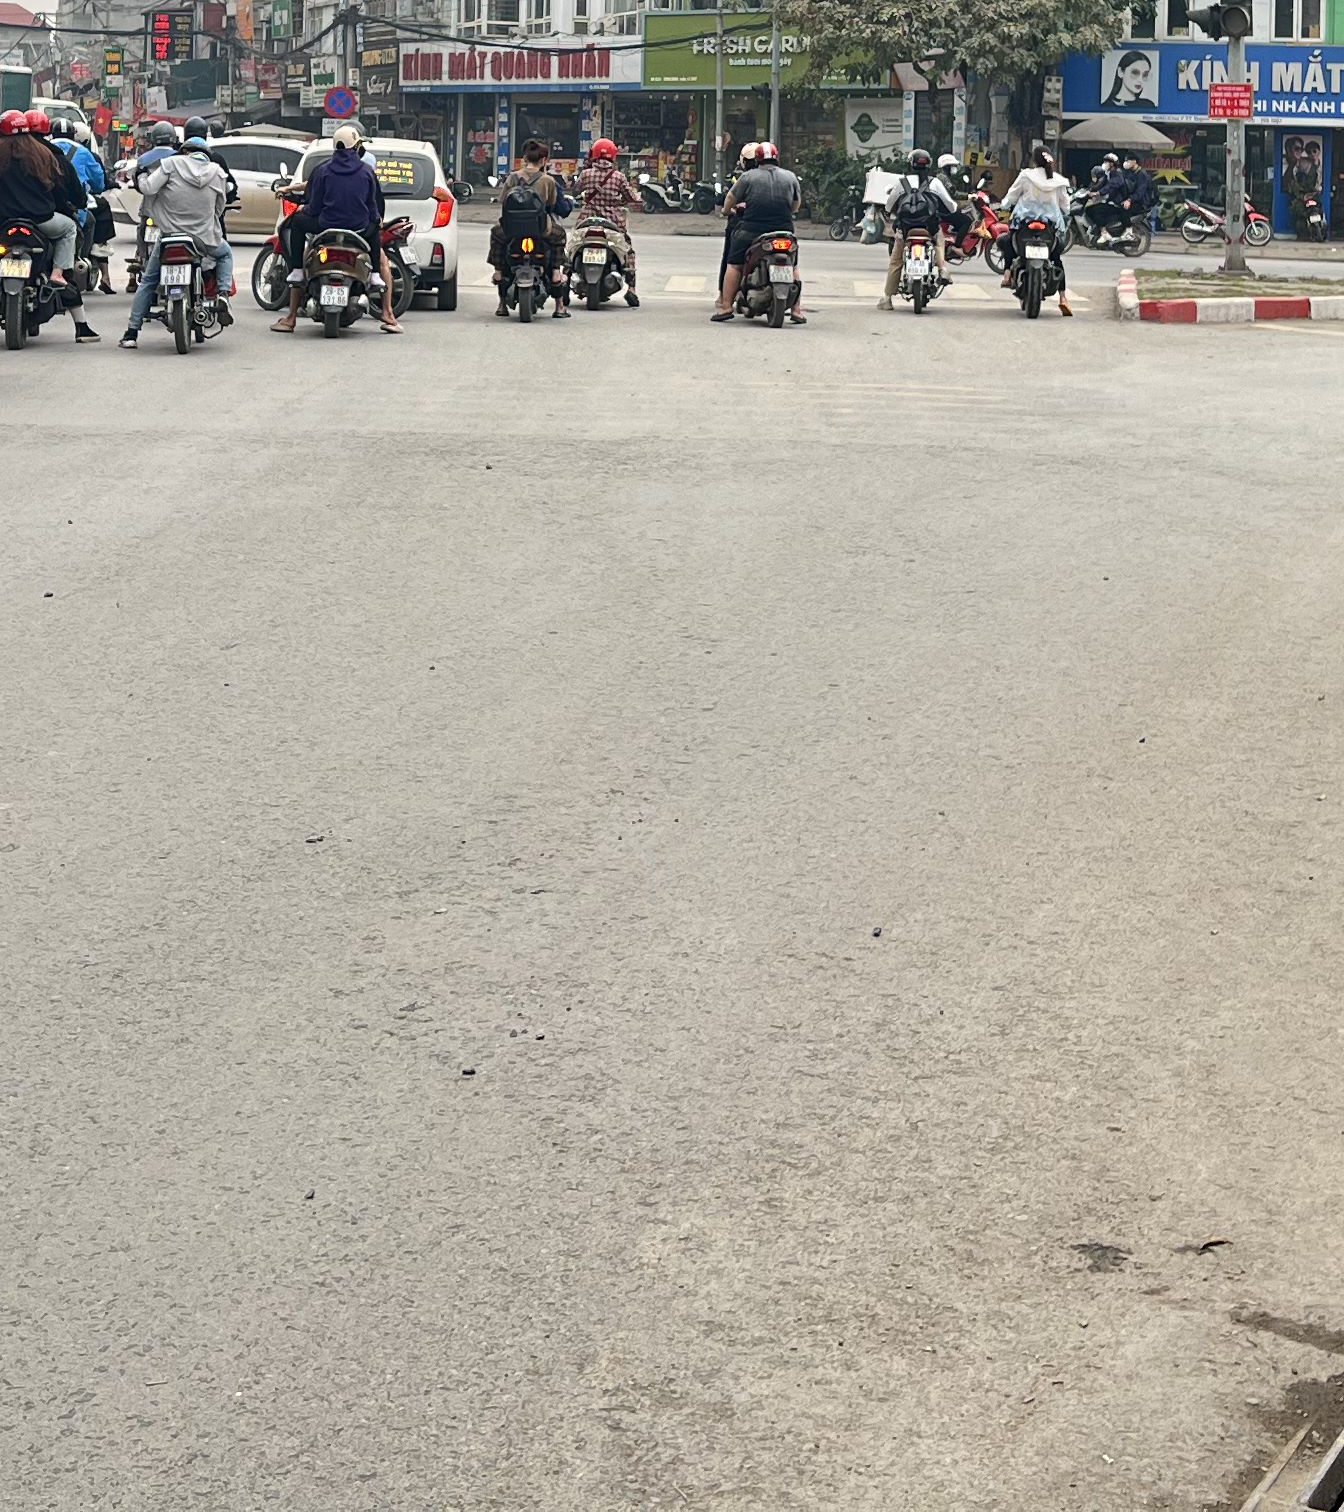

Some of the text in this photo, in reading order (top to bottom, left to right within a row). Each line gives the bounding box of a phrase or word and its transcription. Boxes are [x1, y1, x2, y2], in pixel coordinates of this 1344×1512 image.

[402, 47, 443, 81] KÍNH
[448, 44, 488, 81] MẮT
[490, 49, 551, 82] QUANG
[1272, 96, 1335, 114] NHÁNH
